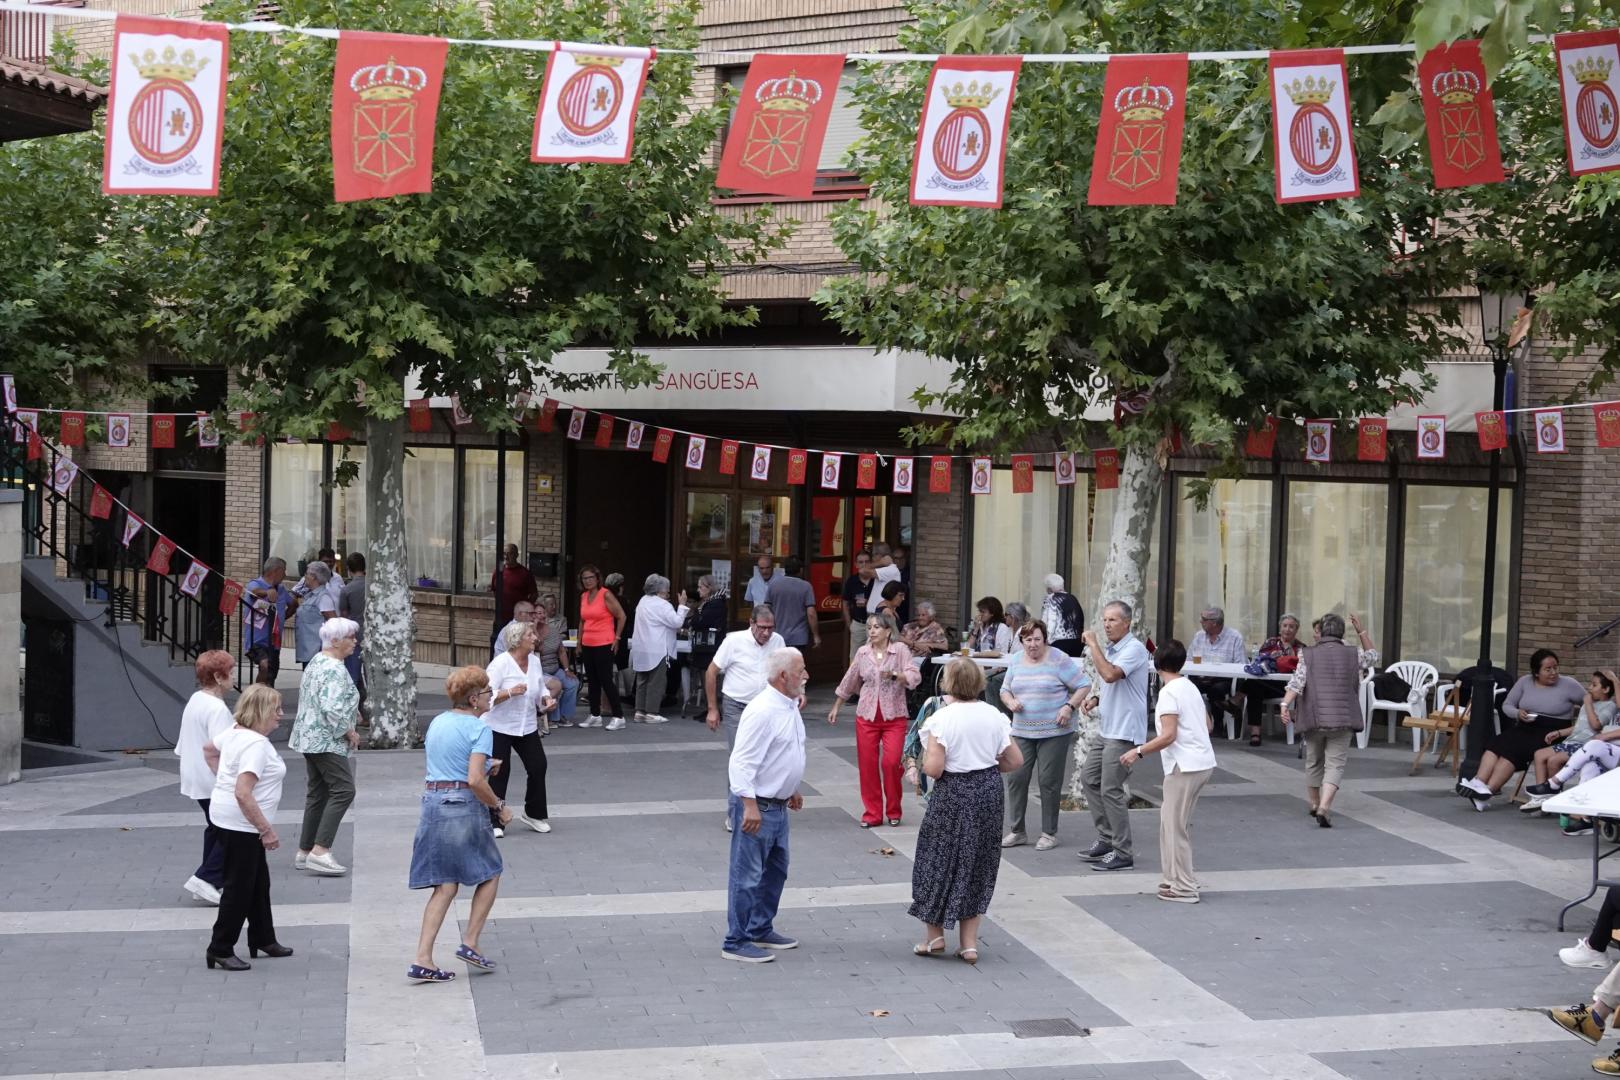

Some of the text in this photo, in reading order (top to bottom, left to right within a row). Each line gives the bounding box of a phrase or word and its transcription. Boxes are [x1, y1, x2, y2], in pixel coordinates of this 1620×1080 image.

[568, 372, 639, 390] CENTR
[655, 369, 759, 390] SANGÜESA
[821, 595, 842, 609] Coca
